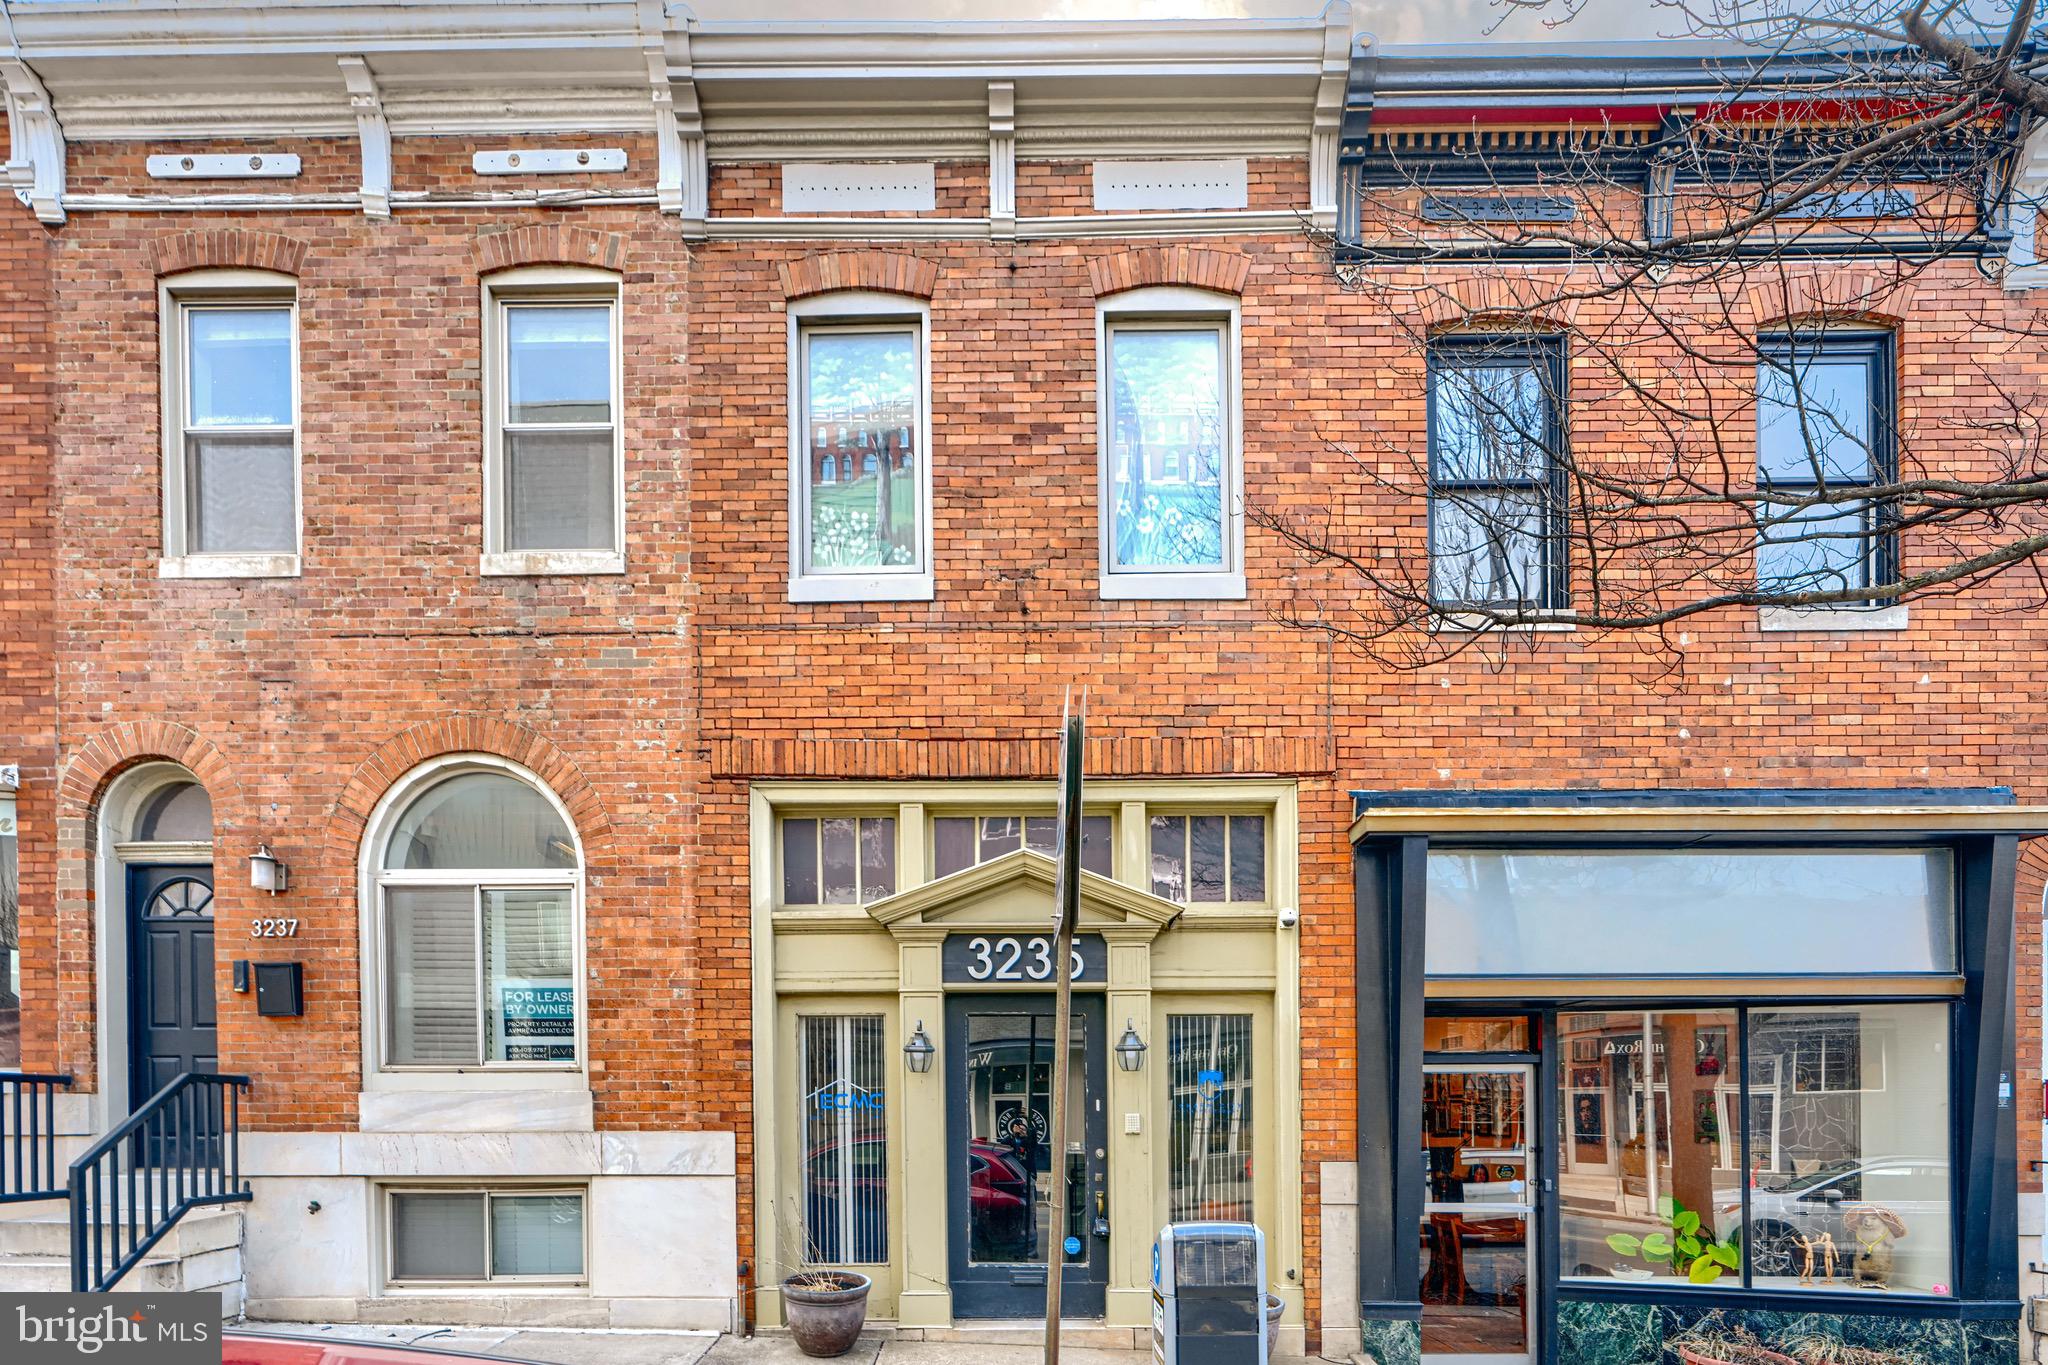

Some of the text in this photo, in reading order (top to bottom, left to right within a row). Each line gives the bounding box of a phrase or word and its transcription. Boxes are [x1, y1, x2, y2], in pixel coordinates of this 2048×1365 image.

[251, 919, 298, 937] 3237
[505, 991, 574, 1002] FOR LEASE
[506, 1004, 574, 1014] BY OWNER
[820, 1093, 884, 1109] ECMC
